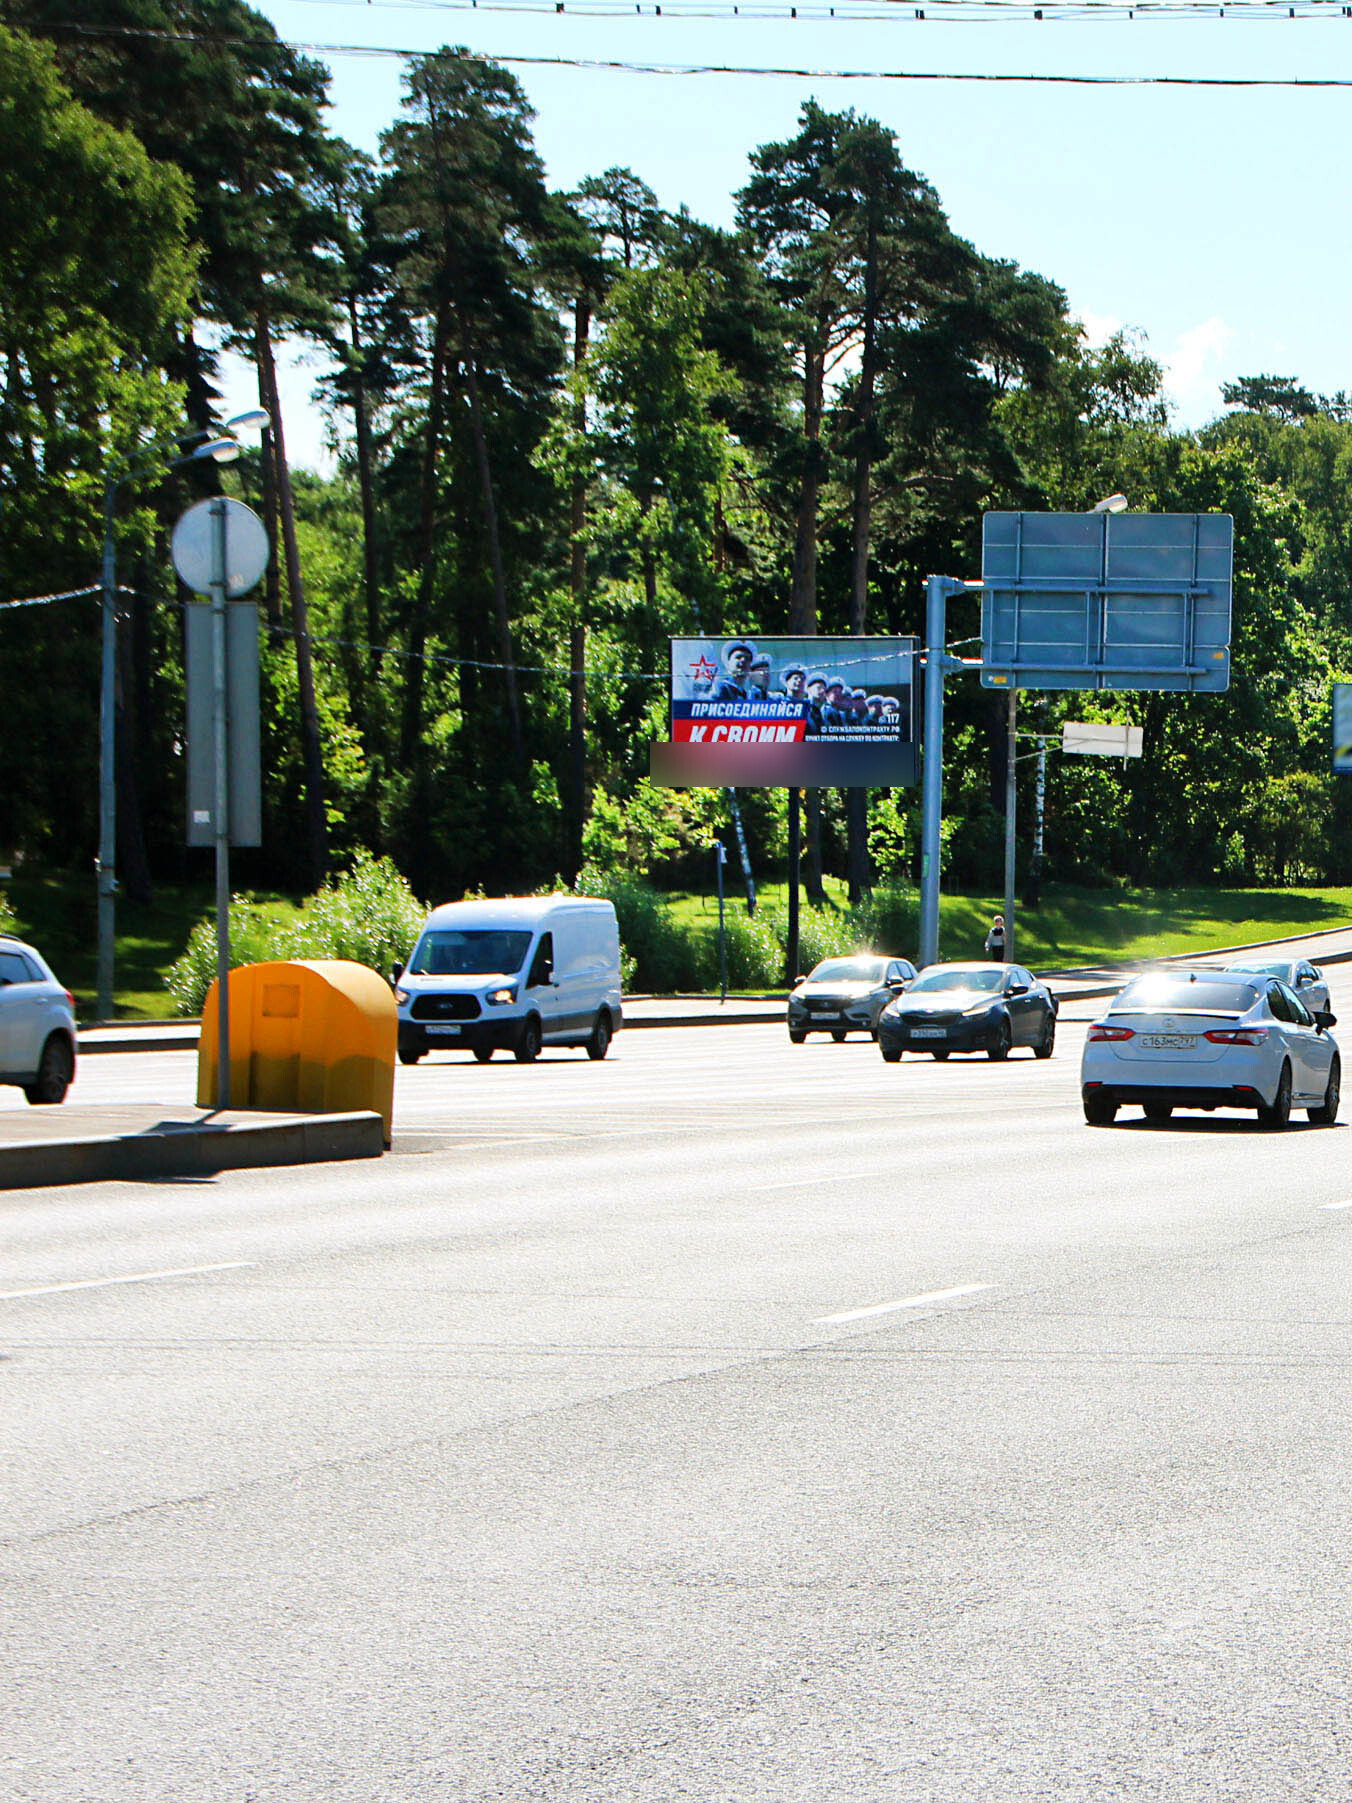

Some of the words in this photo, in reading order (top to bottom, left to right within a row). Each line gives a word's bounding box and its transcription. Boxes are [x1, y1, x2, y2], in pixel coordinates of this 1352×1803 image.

[691, 701, 803, 717] ПРИСОЕДИНЯЙСЯ
[886, 713, 900, 724] 117
[689, 725, 708, 742] К
[711, 725, 797, 742] СВОИМ
